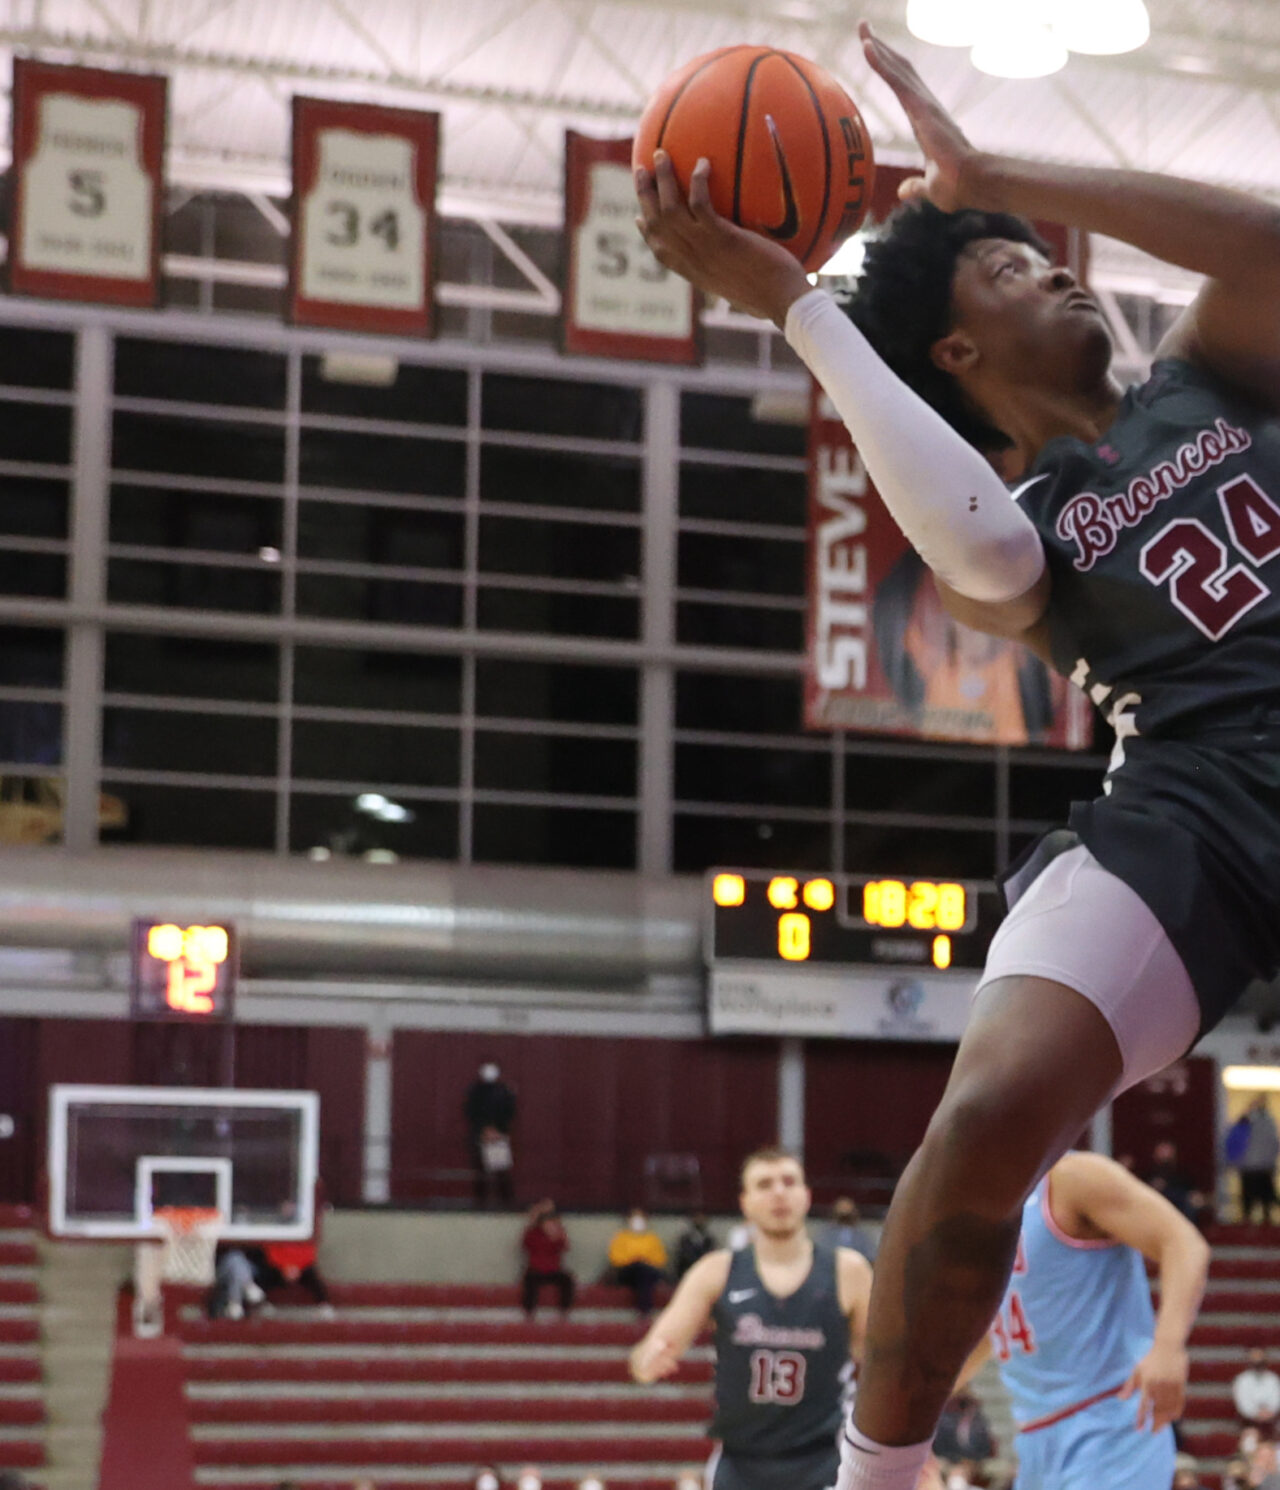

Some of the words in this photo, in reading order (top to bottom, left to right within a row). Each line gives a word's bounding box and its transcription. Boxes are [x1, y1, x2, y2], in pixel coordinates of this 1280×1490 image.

[67, 169, 105, 219] 5
[325, 201, 400, 250] 34
[1056, 418, 1252, 572] Broncos
[815, 446, 868, 691] STEVE
[778, 912, 811, 962] 0
[933, 934, 951, 970] 1
[166, 960, 216, 1014] 12
[748, 1349, 807, 1406] 13
